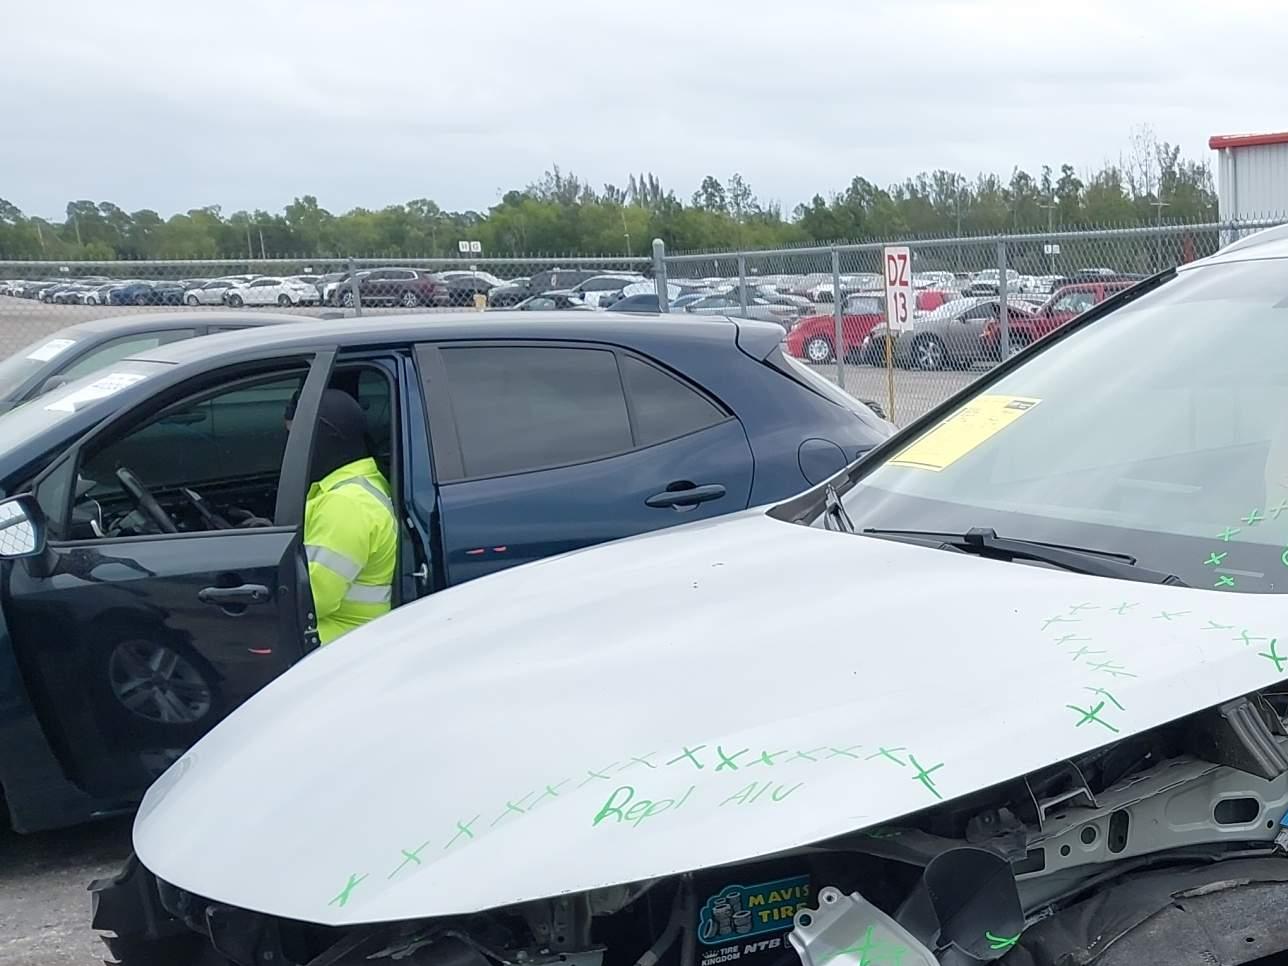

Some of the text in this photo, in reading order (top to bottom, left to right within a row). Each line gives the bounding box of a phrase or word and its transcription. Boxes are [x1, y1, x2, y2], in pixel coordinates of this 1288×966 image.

[888, 254, 908, 287] DZ
[894, 292, 908, 323] 13
[748, 884, 810, 908] MAVIS
[743, 938, 782, 955] NTB
[701, 952, 741, 966] KINGDOM
